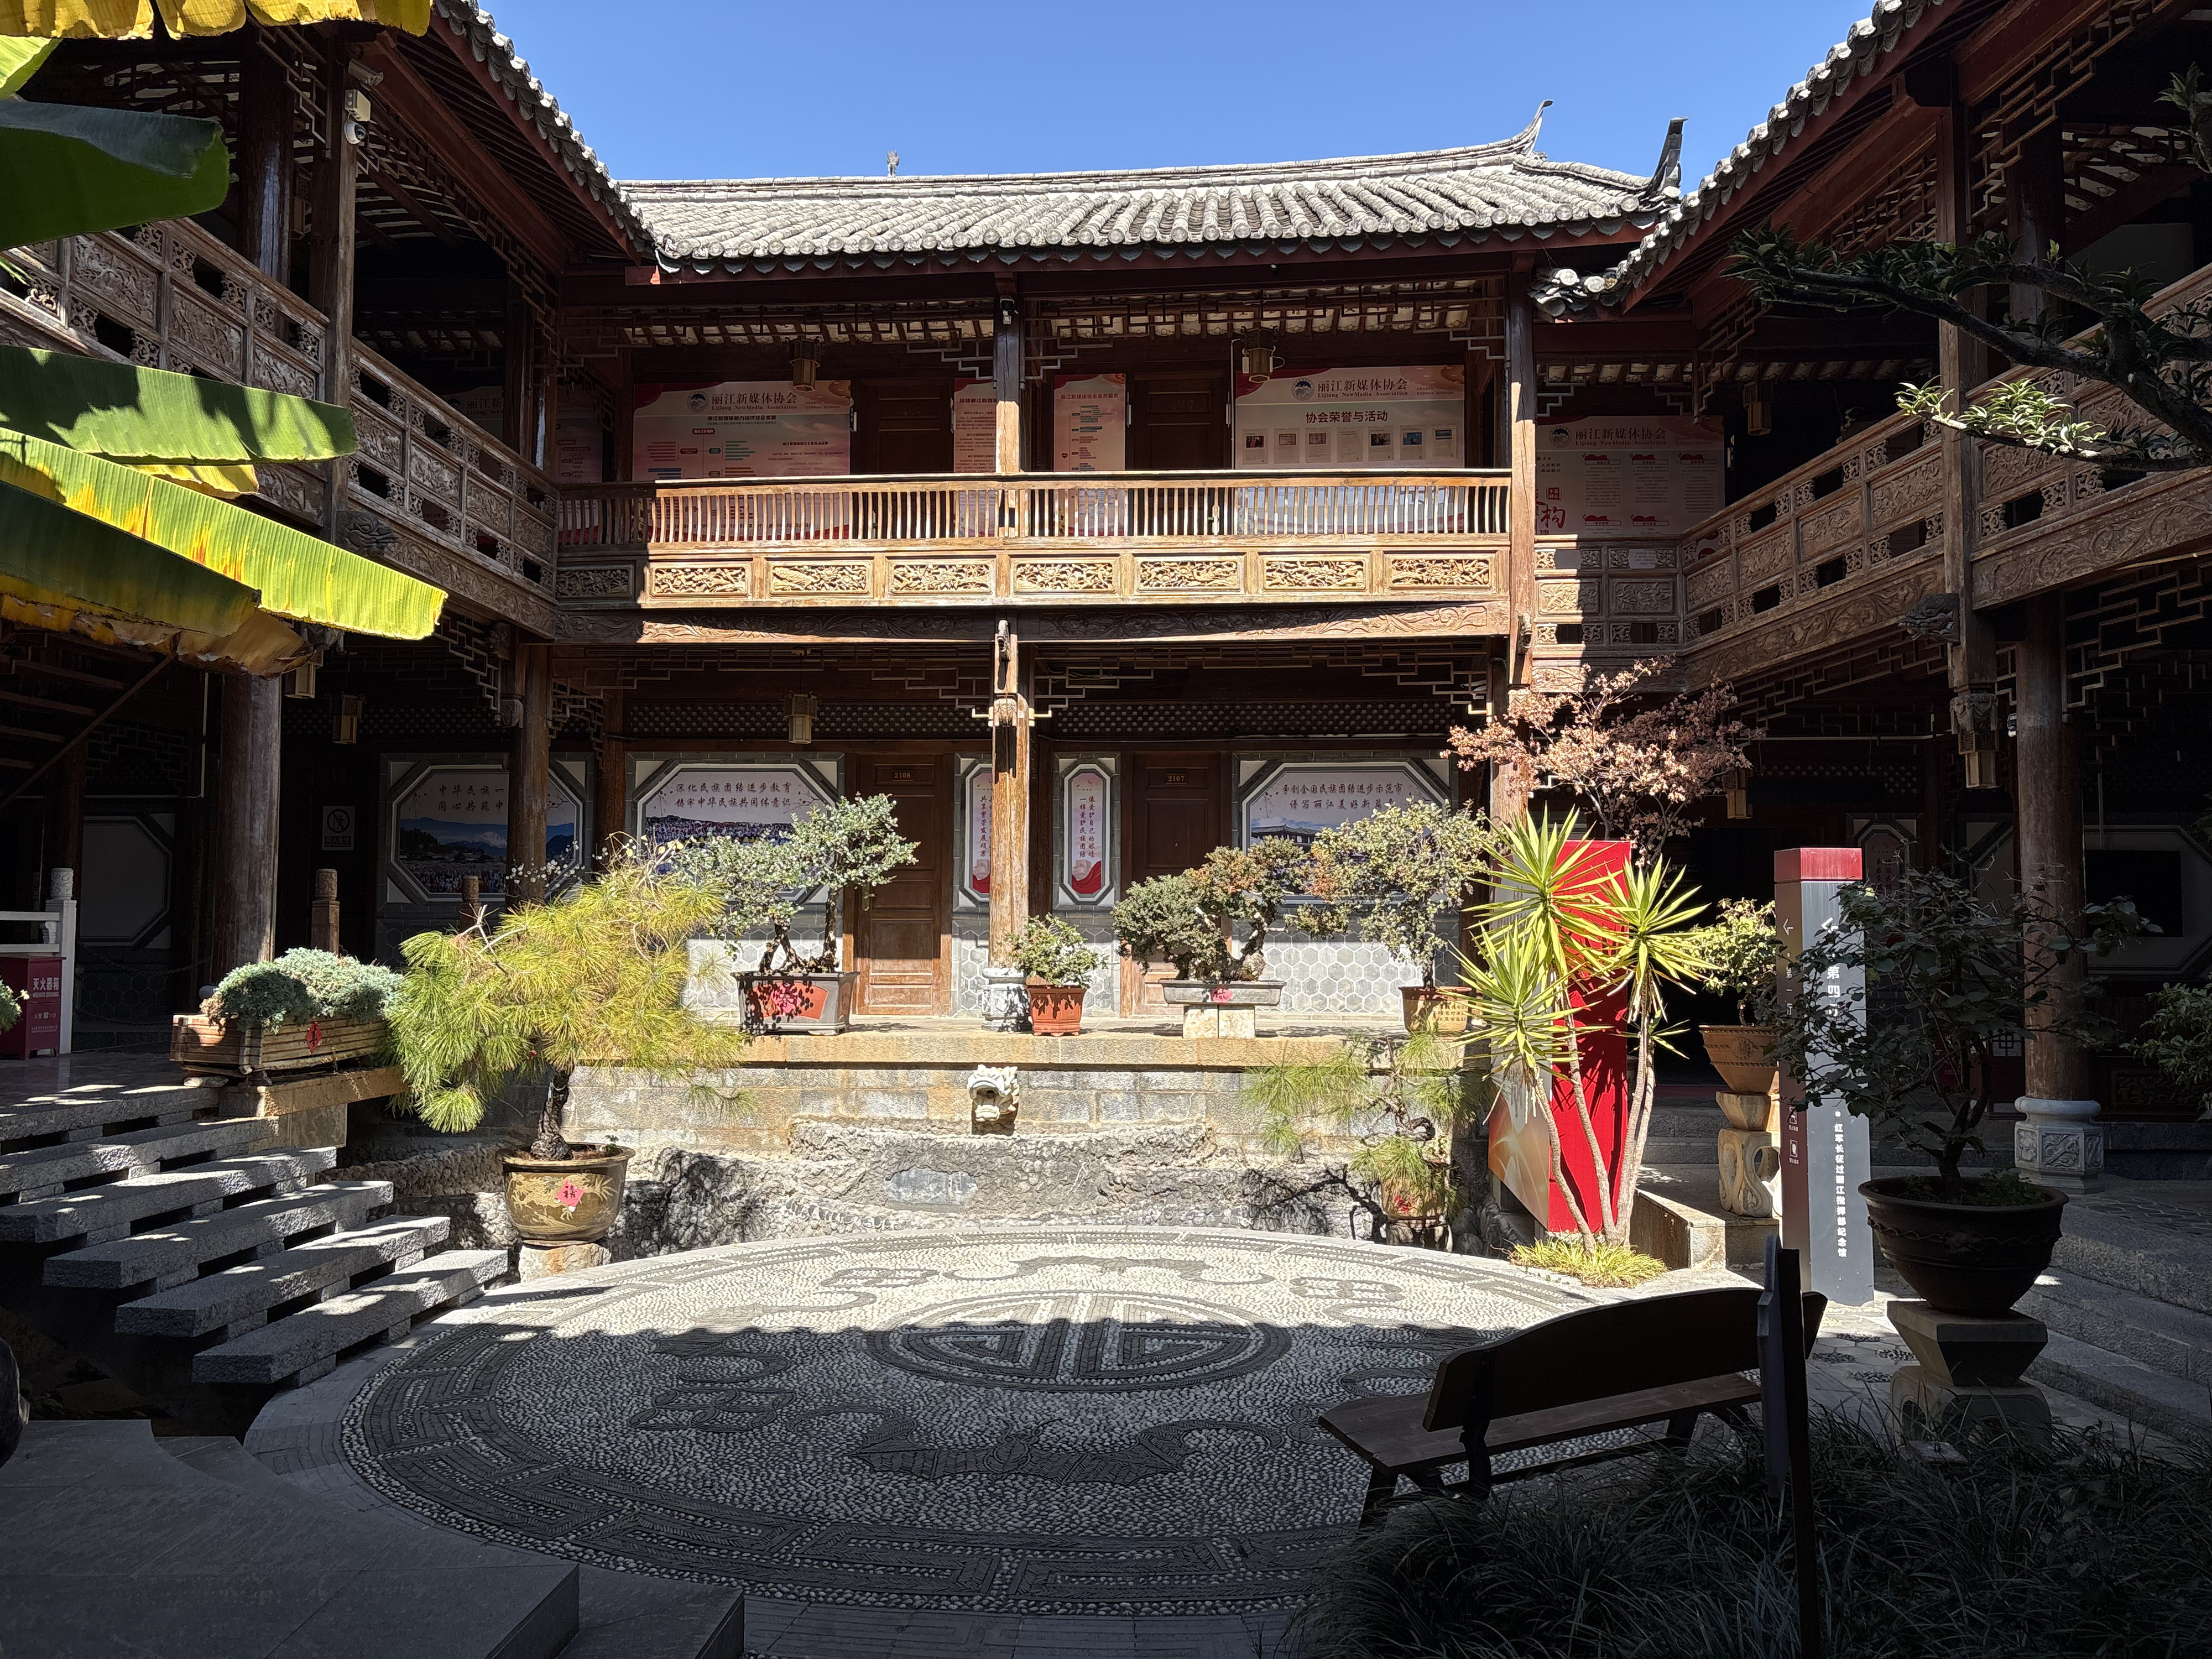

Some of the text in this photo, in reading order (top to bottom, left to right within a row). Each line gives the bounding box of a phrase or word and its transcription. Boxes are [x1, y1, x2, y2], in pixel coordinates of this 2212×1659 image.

[1318, 378, 1408, 392] 丽江新媒体协会
[711, 392, 797, 405] 丽江新媒体协会
[1306, 410, 1389, 424] 协会荣誉与活动
[1575, 427, 1667, 441] 丽江新媒体协会
[676, 782, 791, 794] 深化民族团结进步教育
[1281, 782, 1402, 795] 争创全国民族团结进步示范市
[675, 796, 791, 808] 铸牢中华民族共同体意识
[33, 977, 60, 991] 灭火器箱
[1834, 1123, 1848, 1258] 红军长征过丽江指挥部纪念馆
